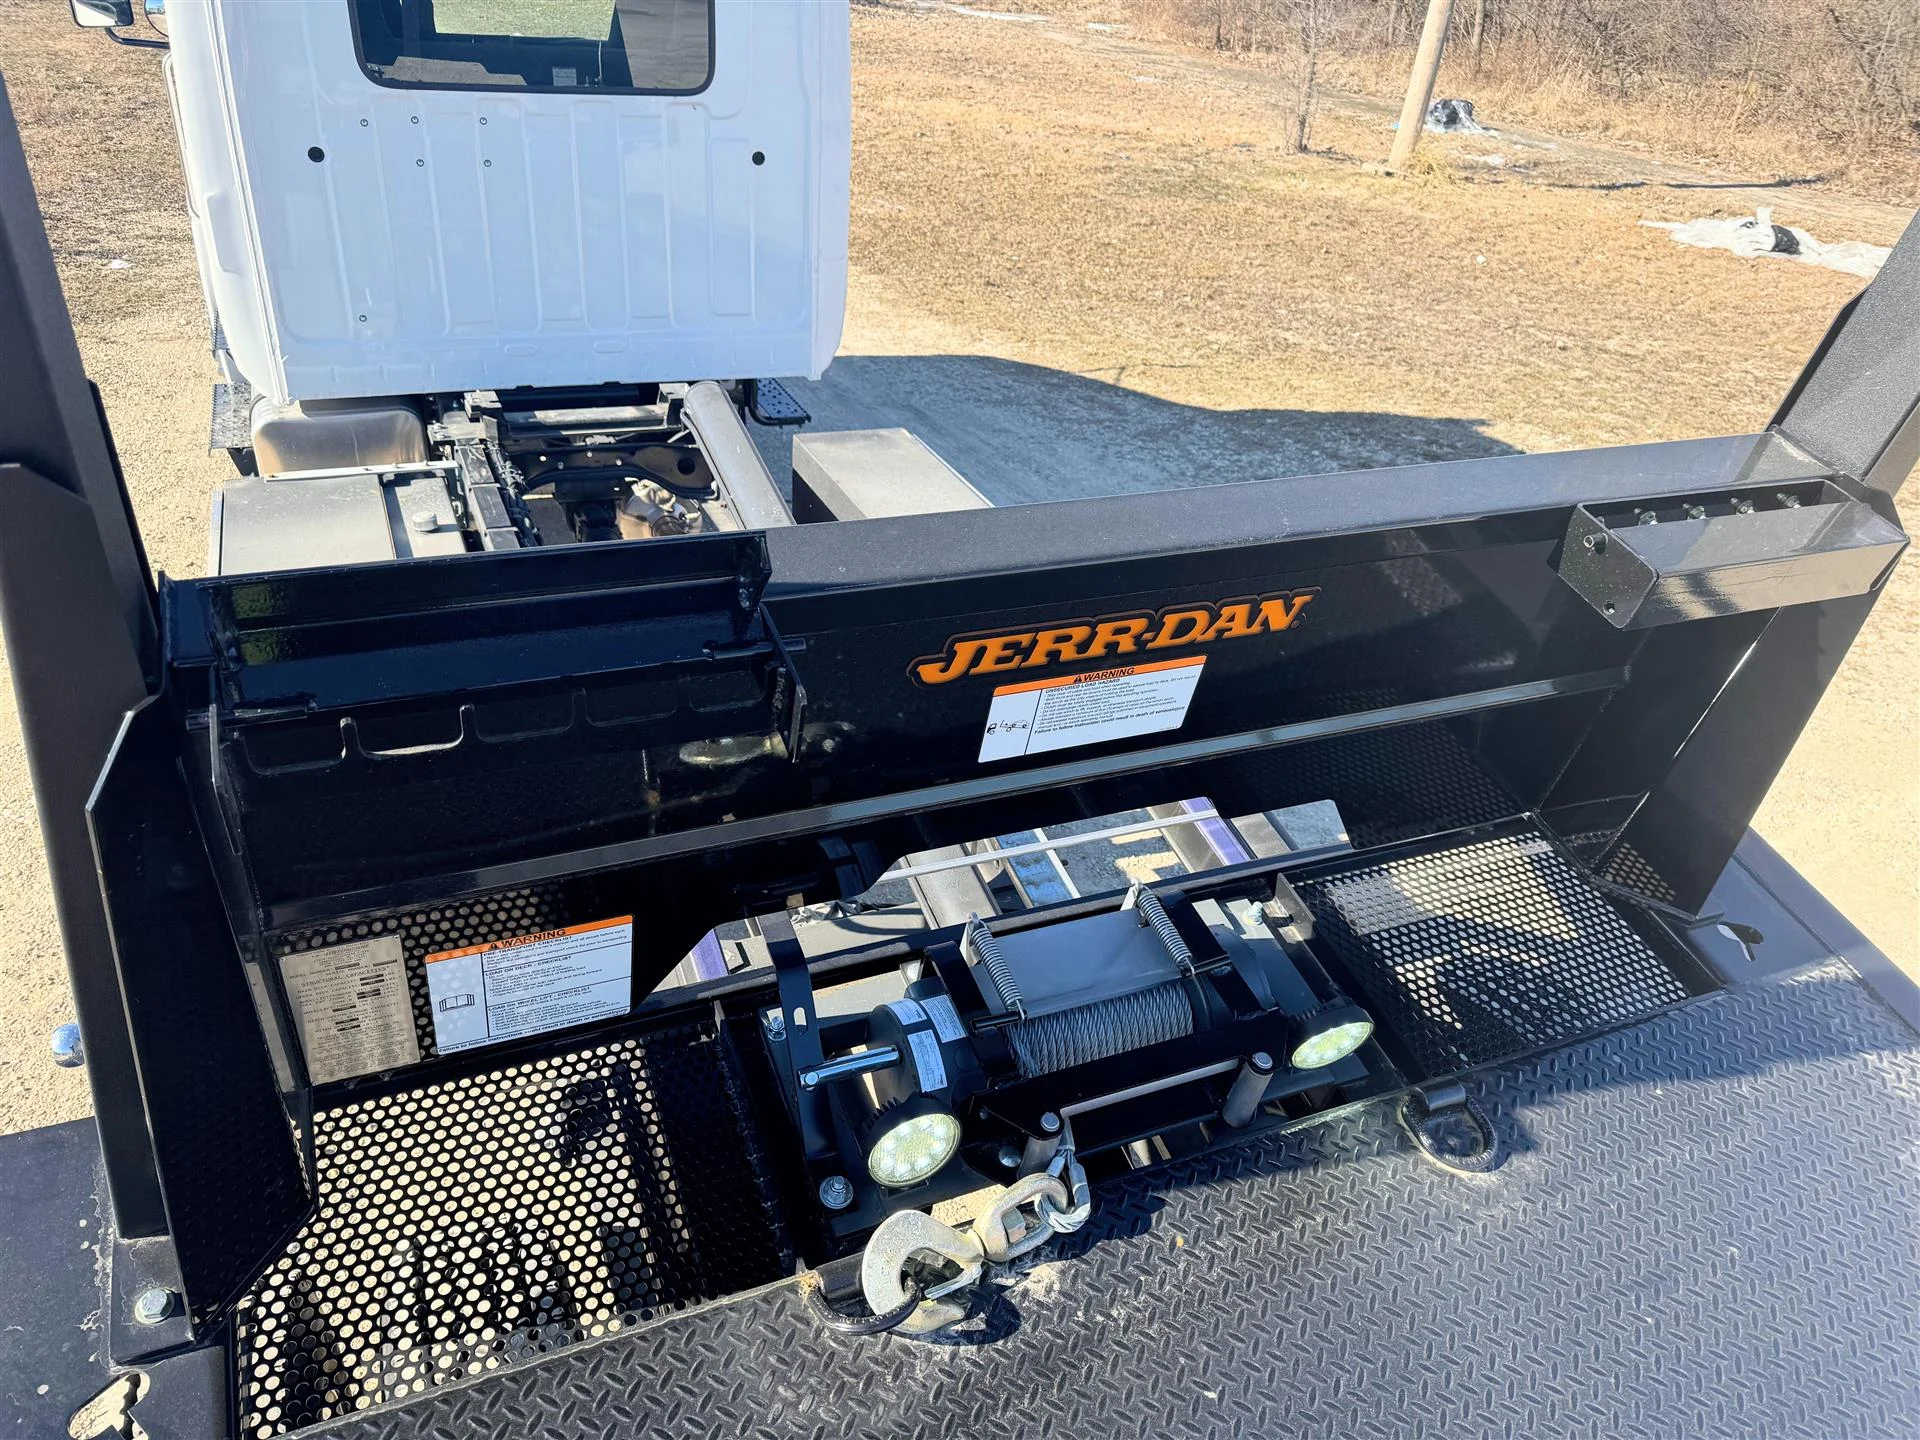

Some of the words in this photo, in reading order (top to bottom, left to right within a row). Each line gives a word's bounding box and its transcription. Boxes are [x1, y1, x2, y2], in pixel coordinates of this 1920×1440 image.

[916, 595, 1314, 684] JERR-DAN
[1083, 667, 1134, 681] WARNING
[1045, 684, 1081, 693] UNSECURED
[500, 928, 565, 947] WARNING
